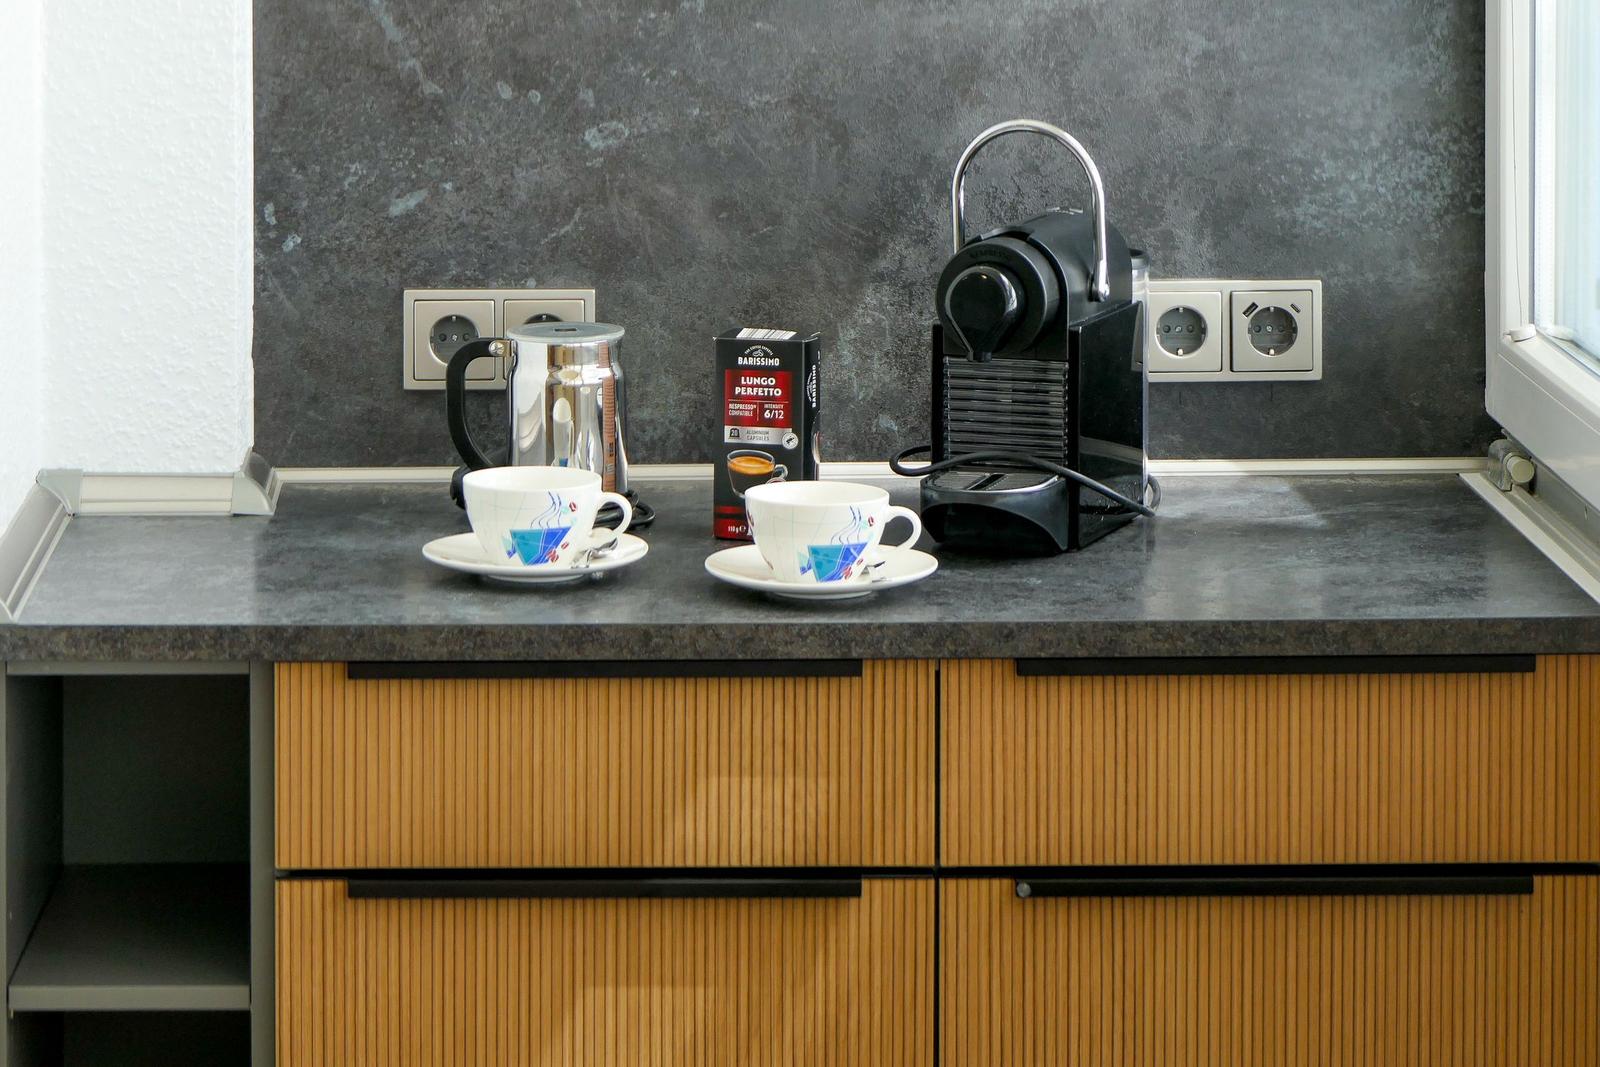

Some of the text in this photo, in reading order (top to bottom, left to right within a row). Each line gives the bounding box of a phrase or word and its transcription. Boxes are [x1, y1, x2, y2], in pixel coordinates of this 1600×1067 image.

[738, 356, 779, 366] BARISSIMO
[741, 376, 775, 385] LUNGO
[735, 387, 782, 396] PERFETTO
[764, 409, 784, 419] 6/12
